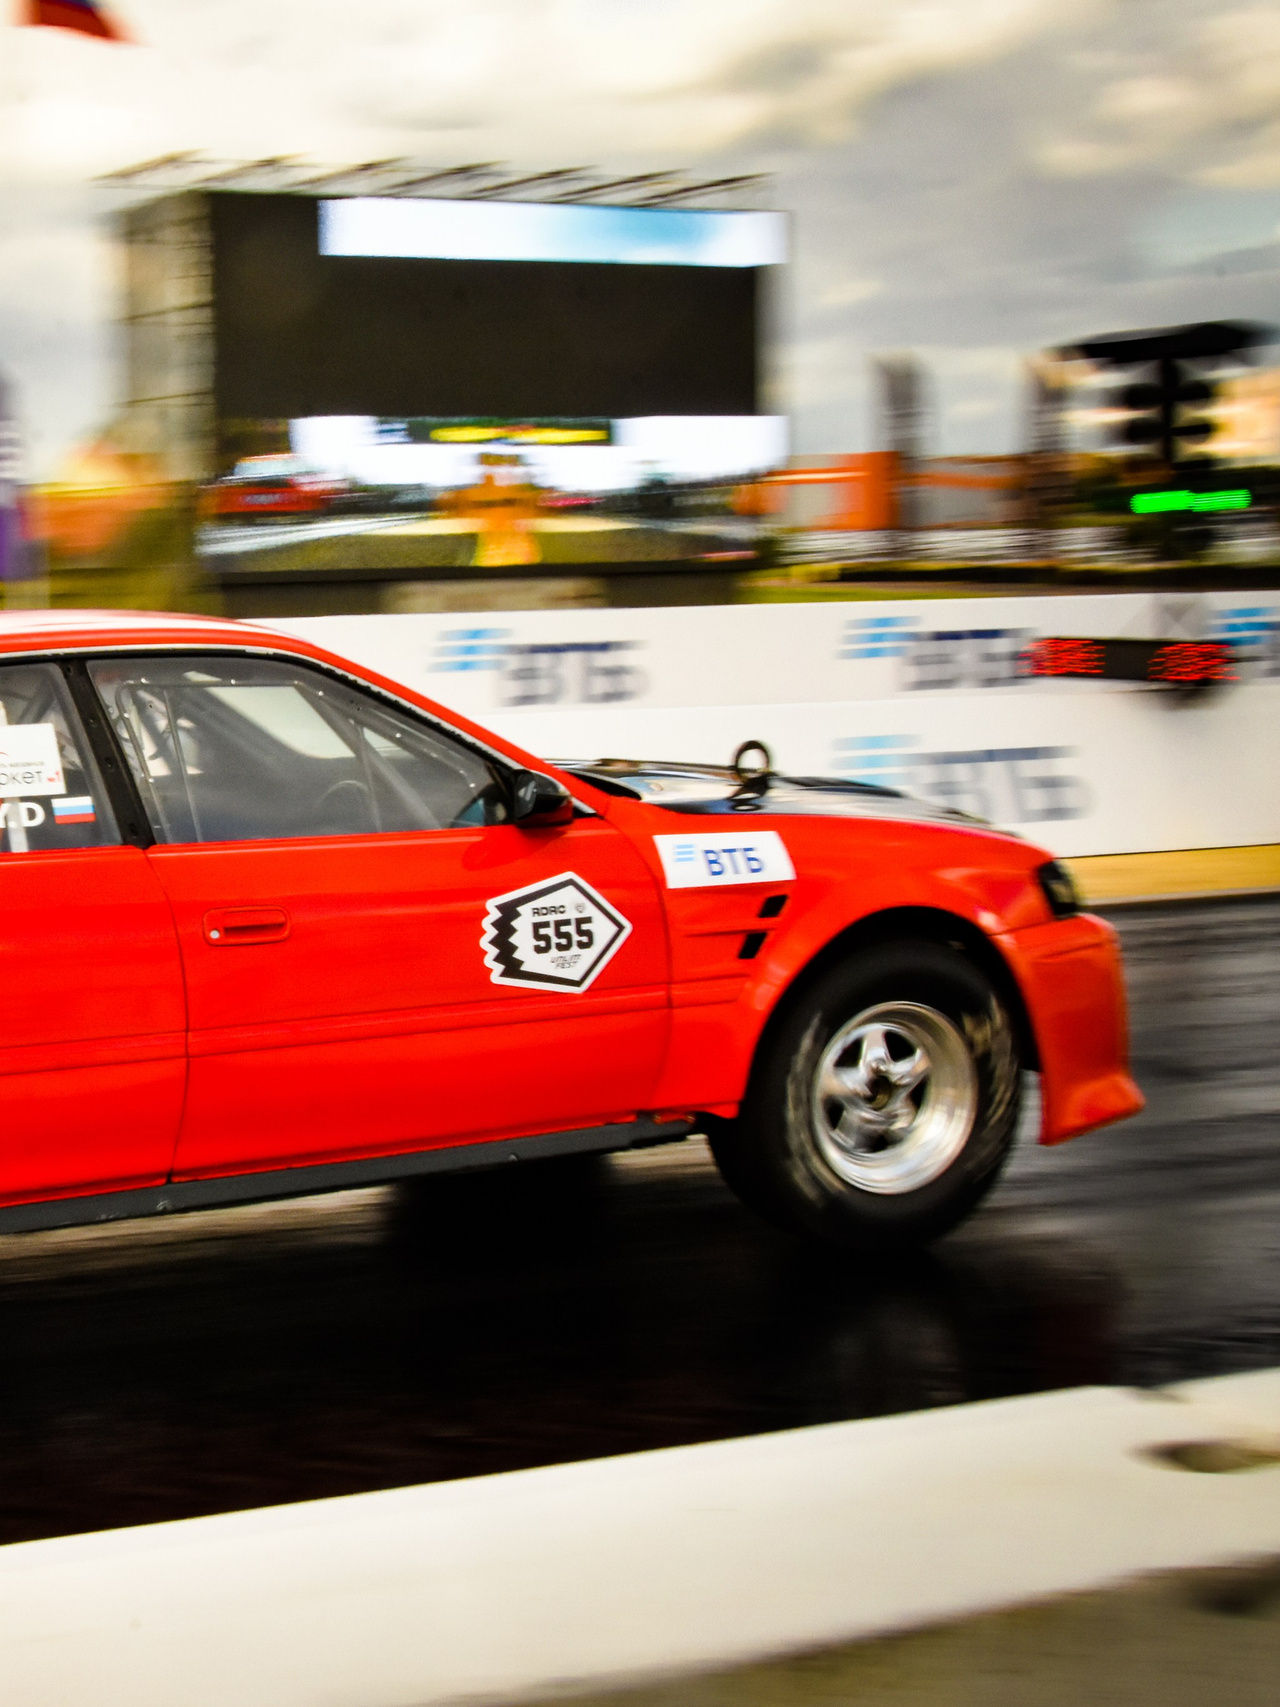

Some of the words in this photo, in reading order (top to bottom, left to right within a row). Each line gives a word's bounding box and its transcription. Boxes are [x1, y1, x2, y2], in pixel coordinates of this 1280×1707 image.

[496, 640, 650, 706] ВТБ
[704, 847, 764, 876] ВТБ
[532, 905, 566, 917] RDRC
[532, 916, 594, 954] 555
